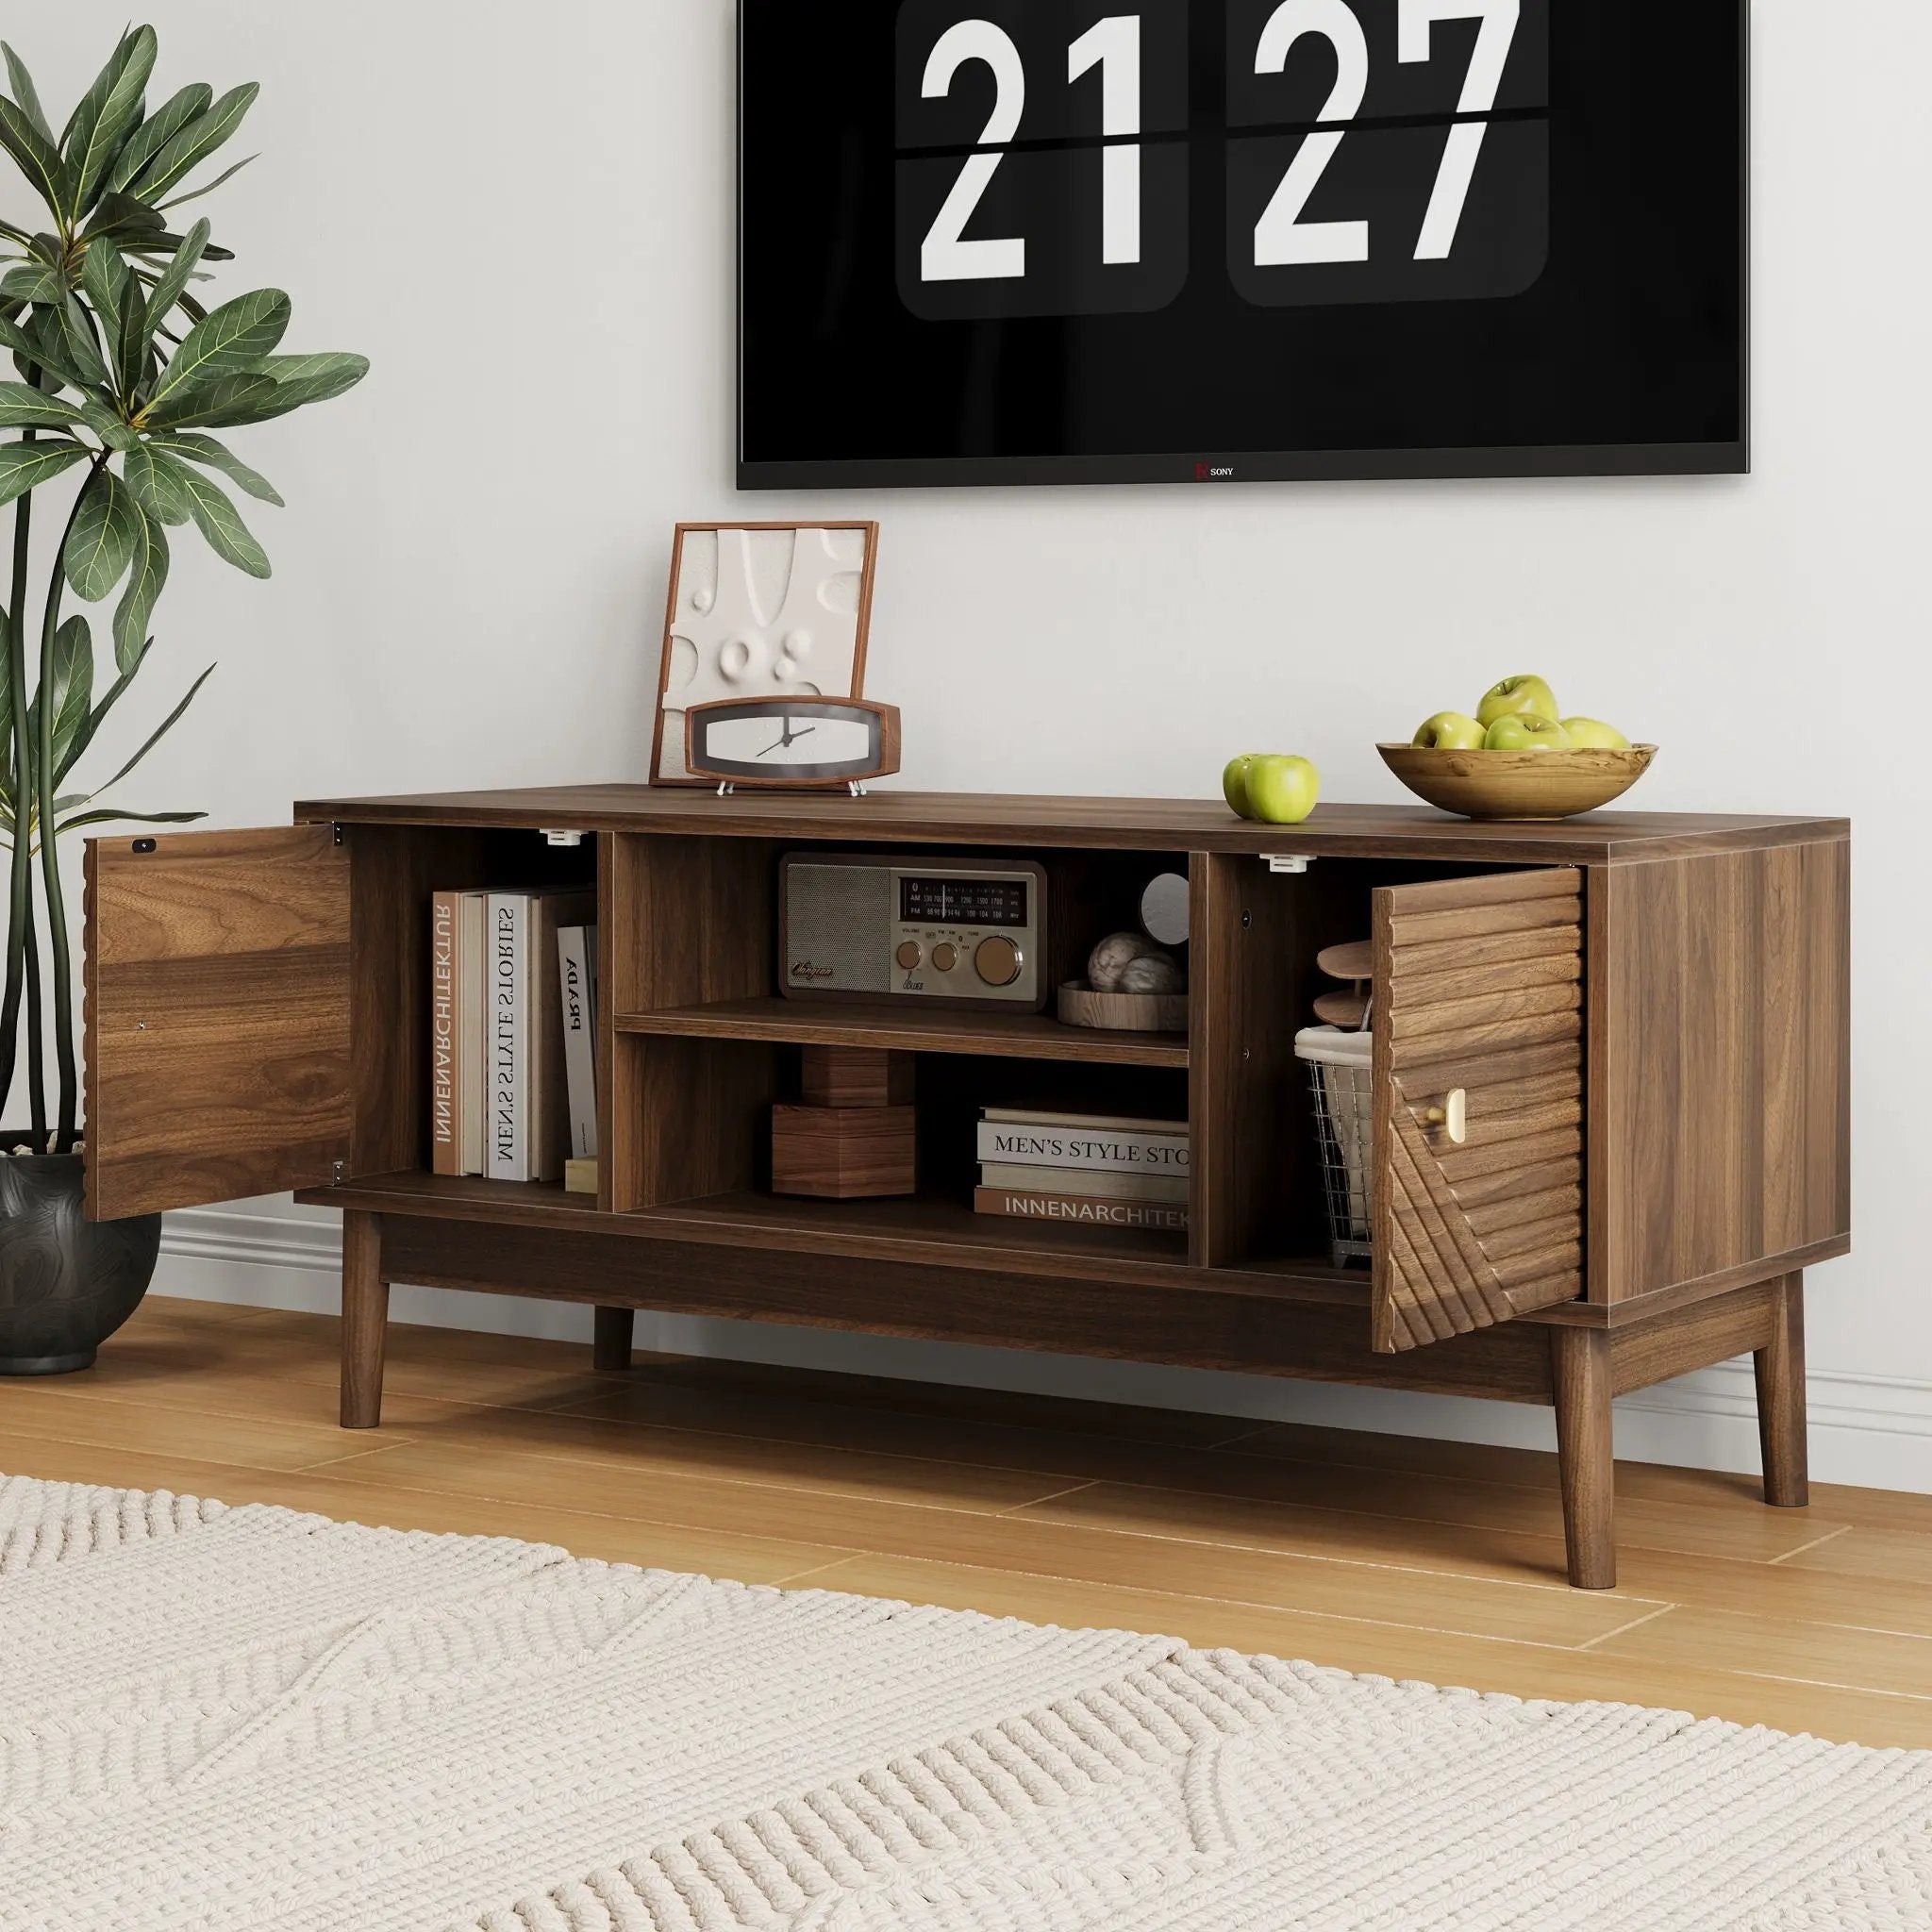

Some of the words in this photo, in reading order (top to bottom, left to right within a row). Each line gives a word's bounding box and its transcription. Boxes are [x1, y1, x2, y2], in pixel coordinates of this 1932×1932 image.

[921, 14, 1141, 281] 21
[1254, 0, 1521, 266] 27
[1210, 467, 1234, 476] SONY
[995, 1135, 1063, 1157] MEN'S
[1069, 1141, 1141, 1161] STYLE
